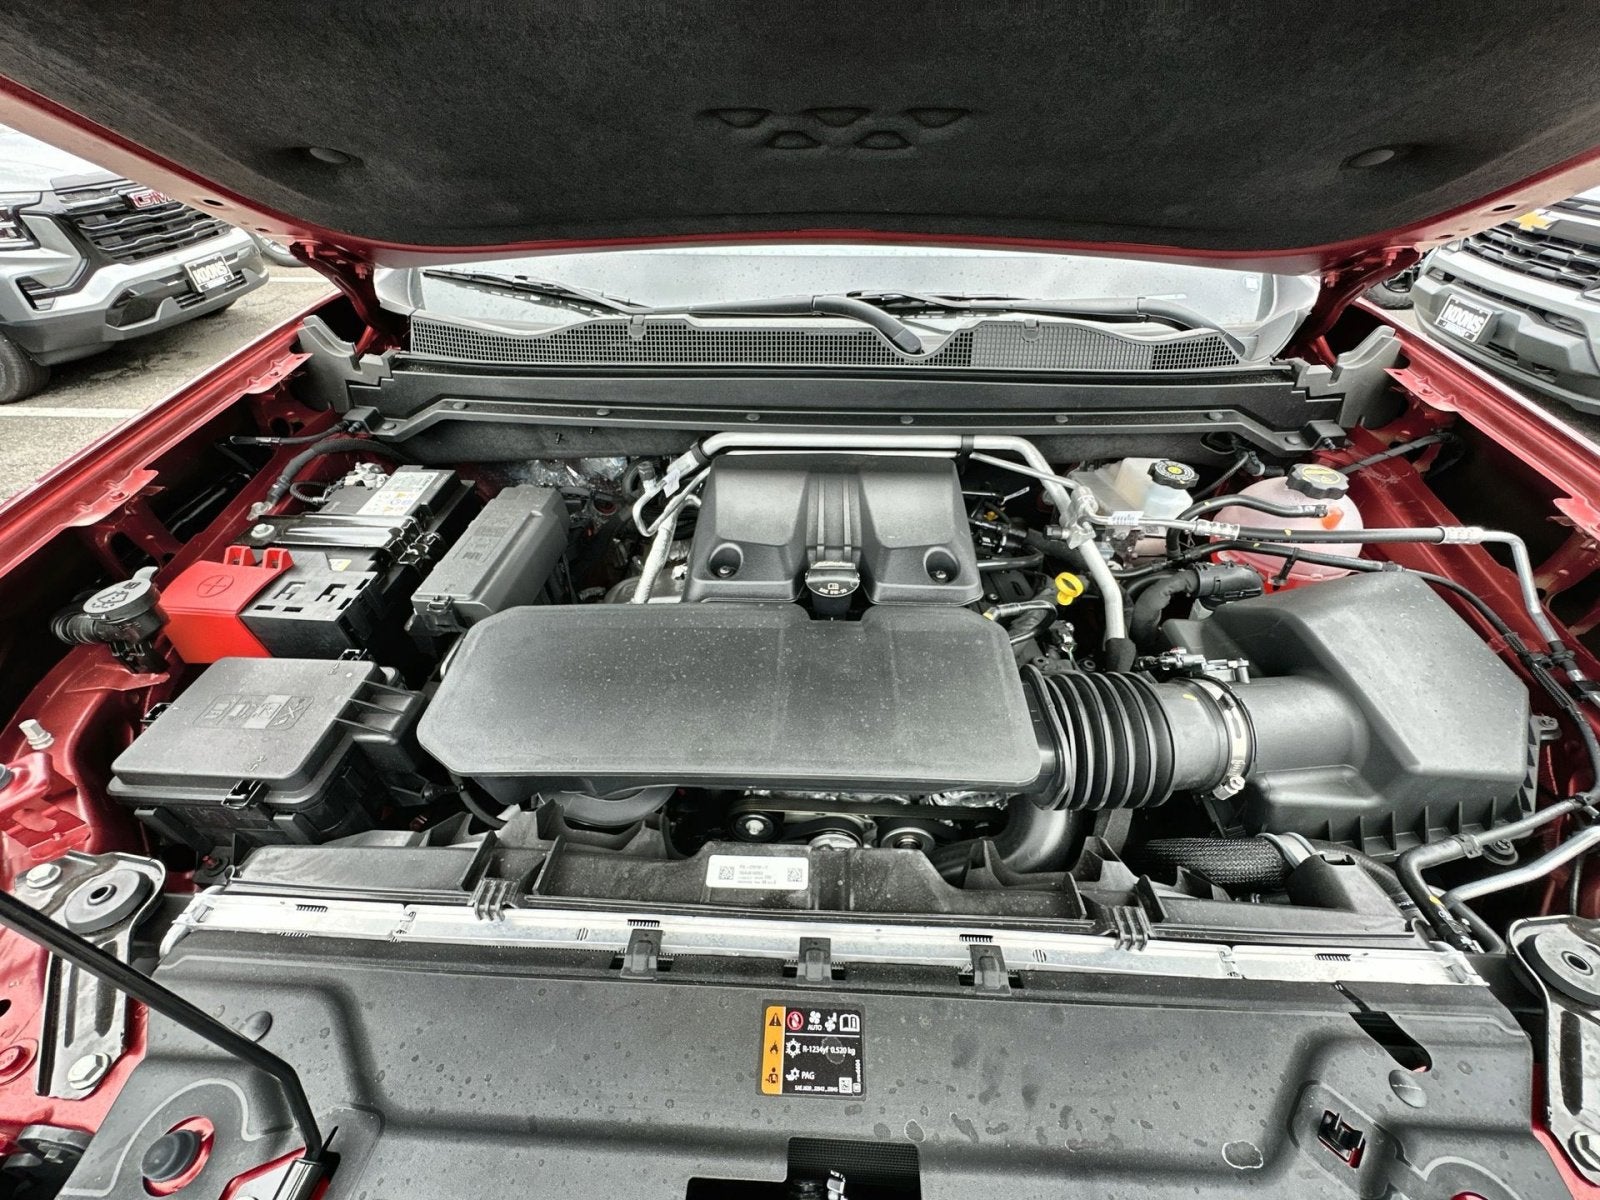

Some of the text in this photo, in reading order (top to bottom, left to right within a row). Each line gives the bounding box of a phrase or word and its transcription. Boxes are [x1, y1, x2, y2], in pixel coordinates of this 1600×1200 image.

[132, 191, 172, 207] GM
[191, 260, 228, 285] KOONS
[1442, 304, 1485, 333] KOONS
[802, 1045, 856, 1056] R-1234yf 0.520 kg
[801, 1071, 815, 1080] PAG
